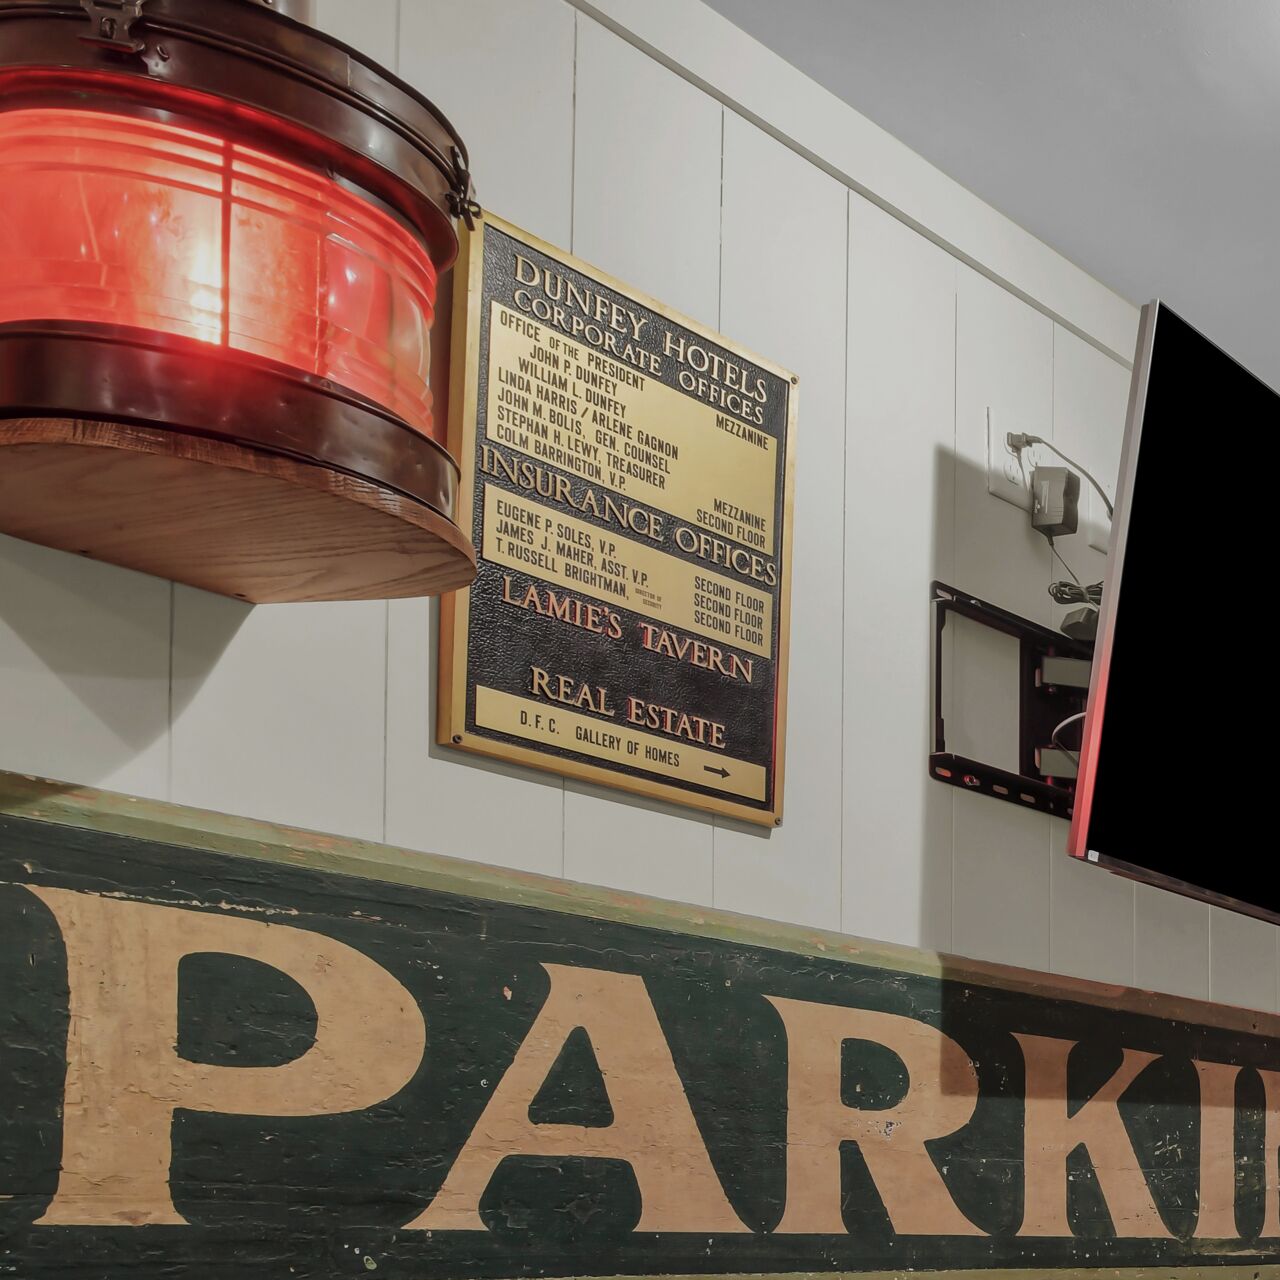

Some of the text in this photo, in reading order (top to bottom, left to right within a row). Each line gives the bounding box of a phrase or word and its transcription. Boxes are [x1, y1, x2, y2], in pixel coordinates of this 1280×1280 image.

[500, 310, 645, 391] OFFICE OF THE PRESIDENT
[514, 254, 768, 403] DUNFEY HOTELS
[514, 289, 764, 425] CORPORATE OFFICES
[518, 357, 627, 419] WILLIAM L. DUNFEY
[530, 345, 618, 397] JOHN P. DUNFEY
[497, 386, 671, 475] JOHN M. BOLIS, GEN. COUNSEL
[498, 366, 532, 395] LINDA
[536, 383, 578, 415] HARRIS
[592, 410, 633, 440] ARLENE
[637, 430, 679, 460] GAGNON
[715, 414, 769, 451] MEZZANINE
[496, 424, 627, 491] COLM BARRINGTON, V.P.
[497, 405, 666, 490] STEPHAN H. LEWY, TREASURER
[478, 444, 777, 586] INSURANCE OFFICES
[496, 500, 617, 560] EUGENE P. SOLES, V.P.
[696, 508, 766, 549] SECOND FLOOR
[713, 498, 767, 533] MEZZANINE
[496, 523, 649, 588] JAMES J. MAHER, ASST. V.P.
[496, 536, 630, 601] T. RUSSELL BRIGHTMAN,
[693, 593, 764, 631] SECOND FLOOR
[694, 576, 765, 615] SECOND FLOOR
[502, 575, 754, 683] LAMIE'S TAVERN
[694, 610, 764, 647] SECOND FLOOR
[530, 665, 727, 749] REAL ESTATE
[575, 726, 621, 753] GALLERY
[627, 738, 640, 756] OF
[645, 742, 681, 768] HOMES
